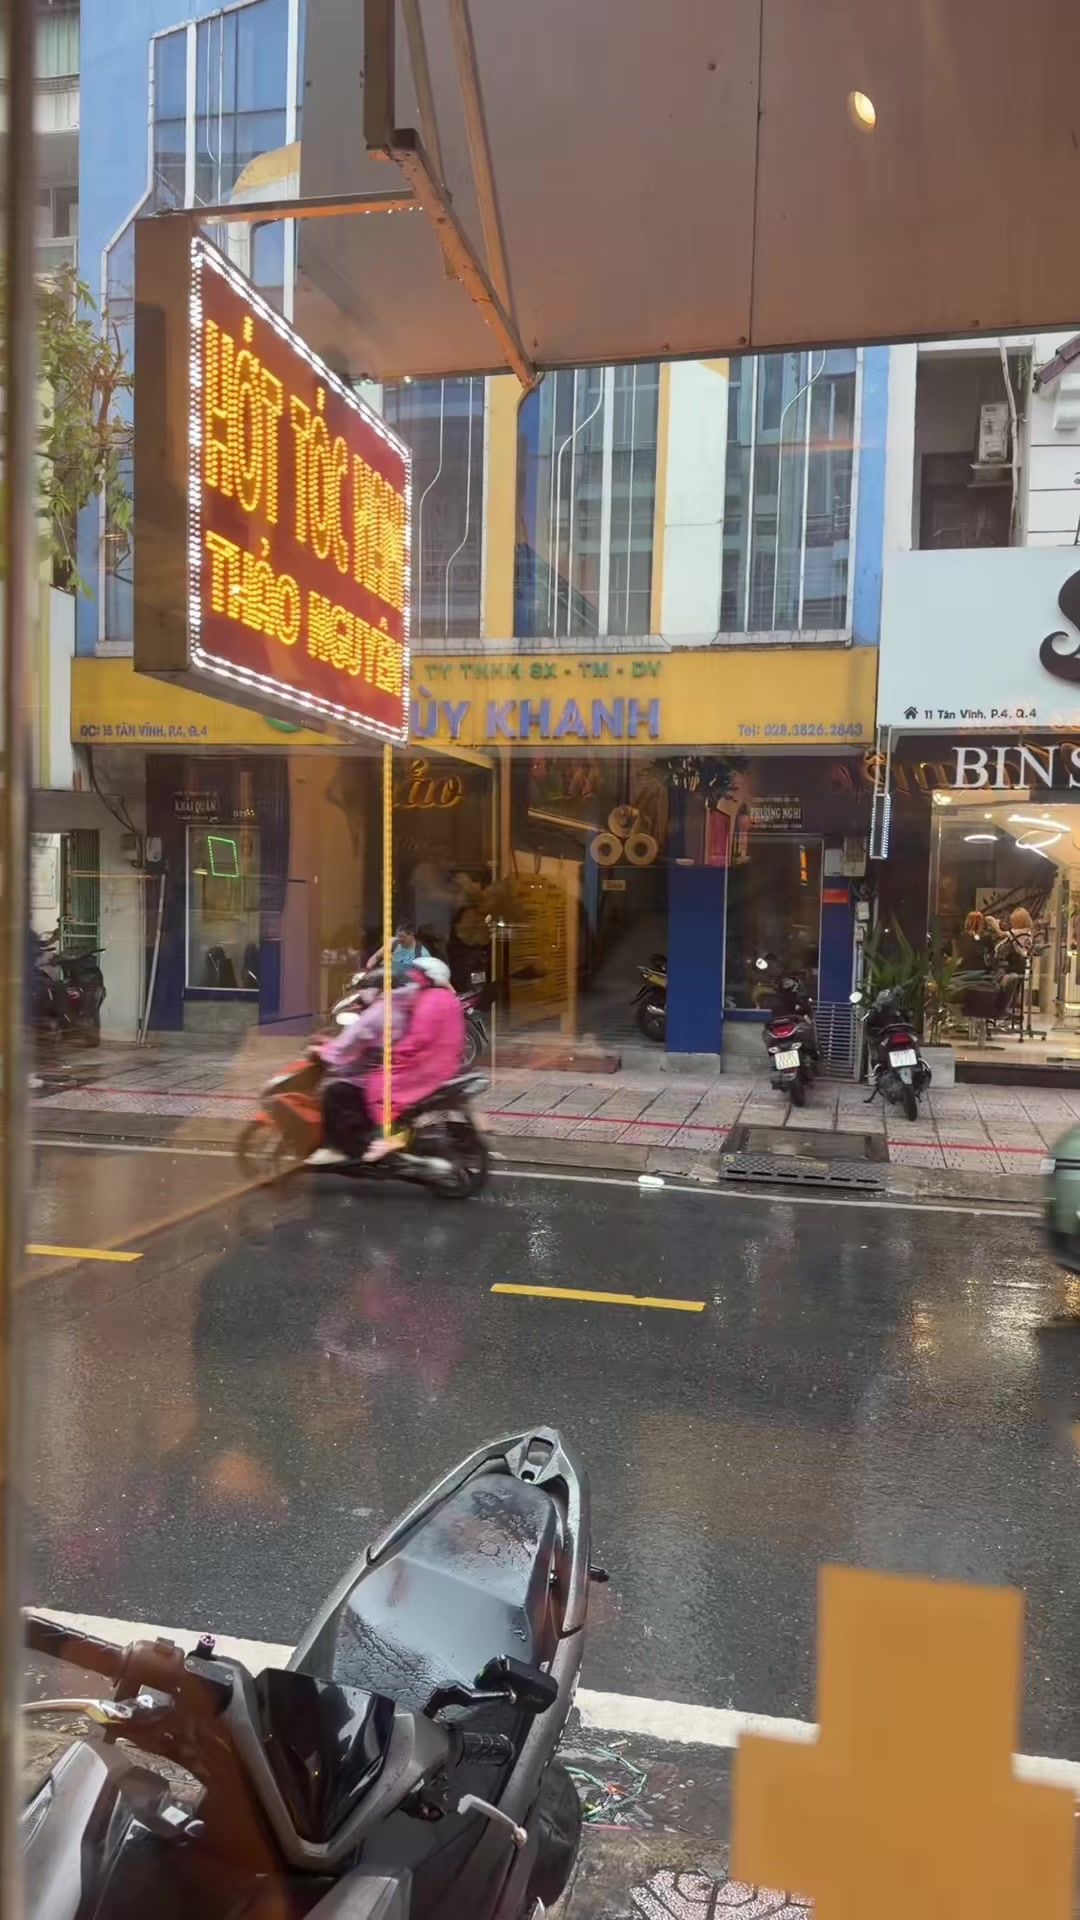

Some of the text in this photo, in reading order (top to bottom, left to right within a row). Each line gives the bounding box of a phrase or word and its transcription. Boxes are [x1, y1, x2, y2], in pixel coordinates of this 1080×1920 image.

[205, 316, 283, 524] HỚT
[290, 387, 349, 574] TÓC
[205, 537, 403, 697] THẢO NGUYÊN
[425, 664, 452, 681] TY
[485, 699, 661, 739] KHANH
[924, 710, 933, 719] 11
[938, 710, 956, 719] Tân
